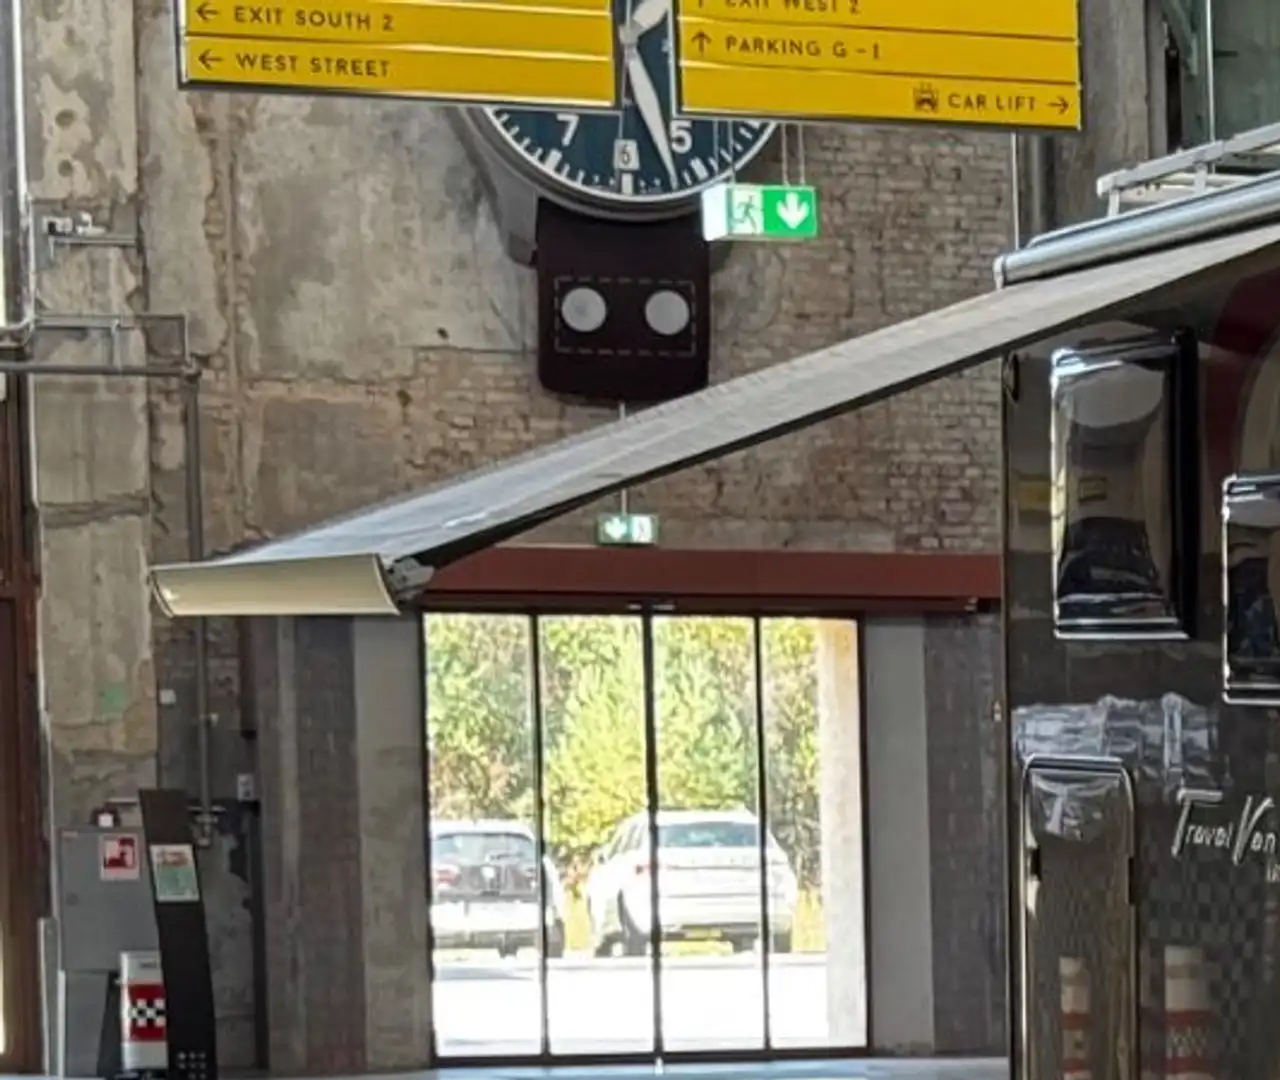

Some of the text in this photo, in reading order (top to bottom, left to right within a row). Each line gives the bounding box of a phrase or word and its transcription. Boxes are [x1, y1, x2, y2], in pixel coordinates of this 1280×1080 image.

[233, 6, 395, 32] EXIT SOUTH 2
[726, 36, 822, 56] PARKING
[235, 54, 392, 78] WEST STREET
[947, 92, 1036, 112] CAR LIFT
[556, 113, 580, 147] 7
[670, 120, 693, 154] 5
[1170, 789, 1277, 867] Travel Van
